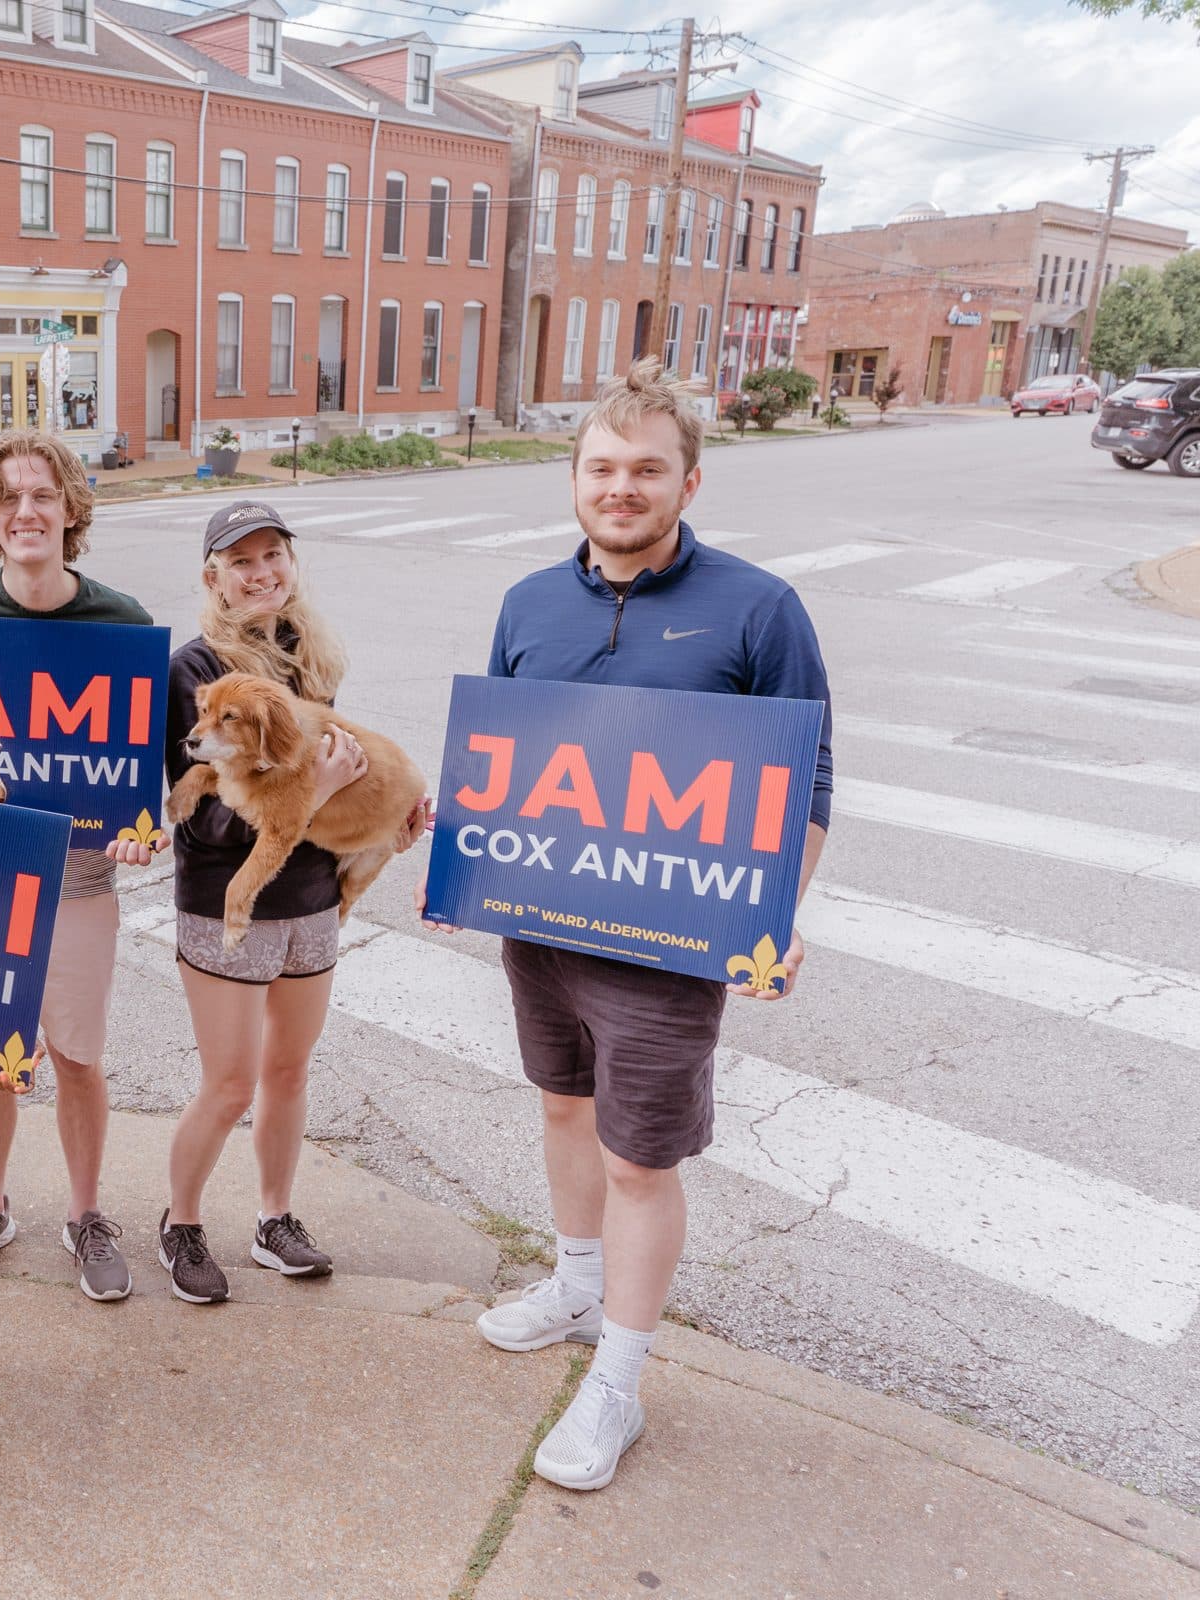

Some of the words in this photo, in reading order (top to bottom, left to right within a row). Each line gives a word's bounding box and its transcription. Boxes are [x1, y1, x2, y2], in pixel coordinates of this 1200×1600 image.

[72, 818, 103, 830] MAN
[455, 733, 791, 853] JAMI
[456, 824, 557, 871] COX
[570, 842, 764, 905] ANTWI
[483, 898, 512, 914] FOR
[513, 903, 524, 916] 8
[527, 904, 538, 913] TH
[541, 909, 588, 930] WARD
[590, 919, 709, 953] ALDERWOMAN
